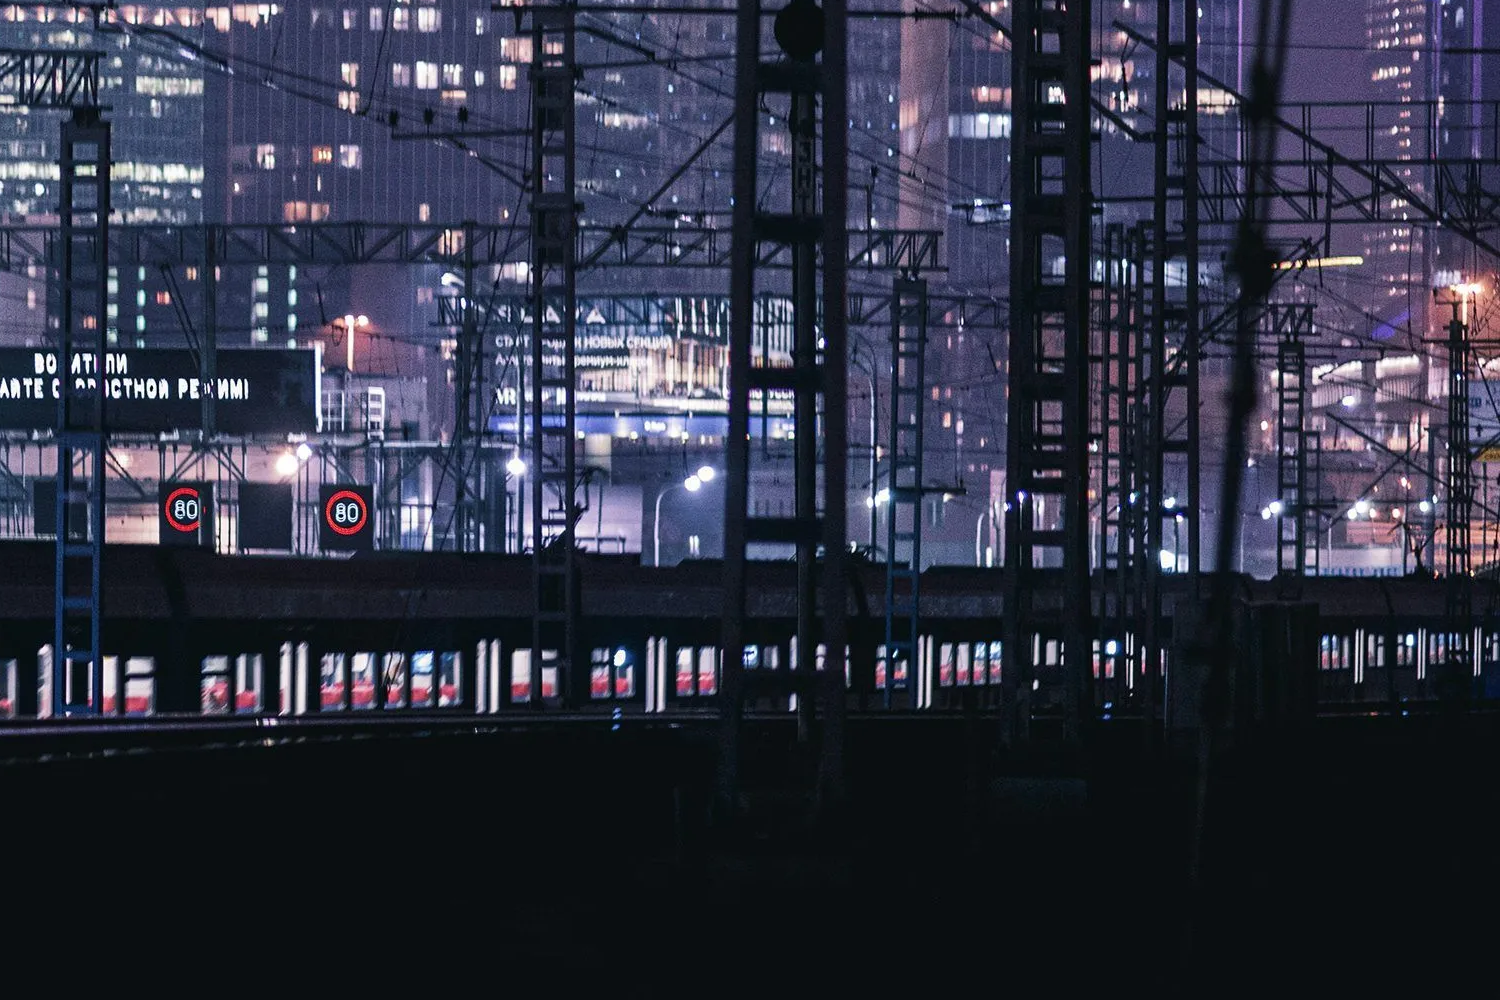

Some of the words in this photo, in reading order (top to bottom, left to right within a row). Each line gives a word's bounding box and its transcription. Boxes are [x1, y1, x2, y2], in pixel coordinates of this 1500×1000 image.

[34, 352, 128, 375] ВОИТЛИ
[51, 377, 169, 399] ССТНОЙ
[174, 499, 198, 520] 80
[335, 502, 359, 523] 80
